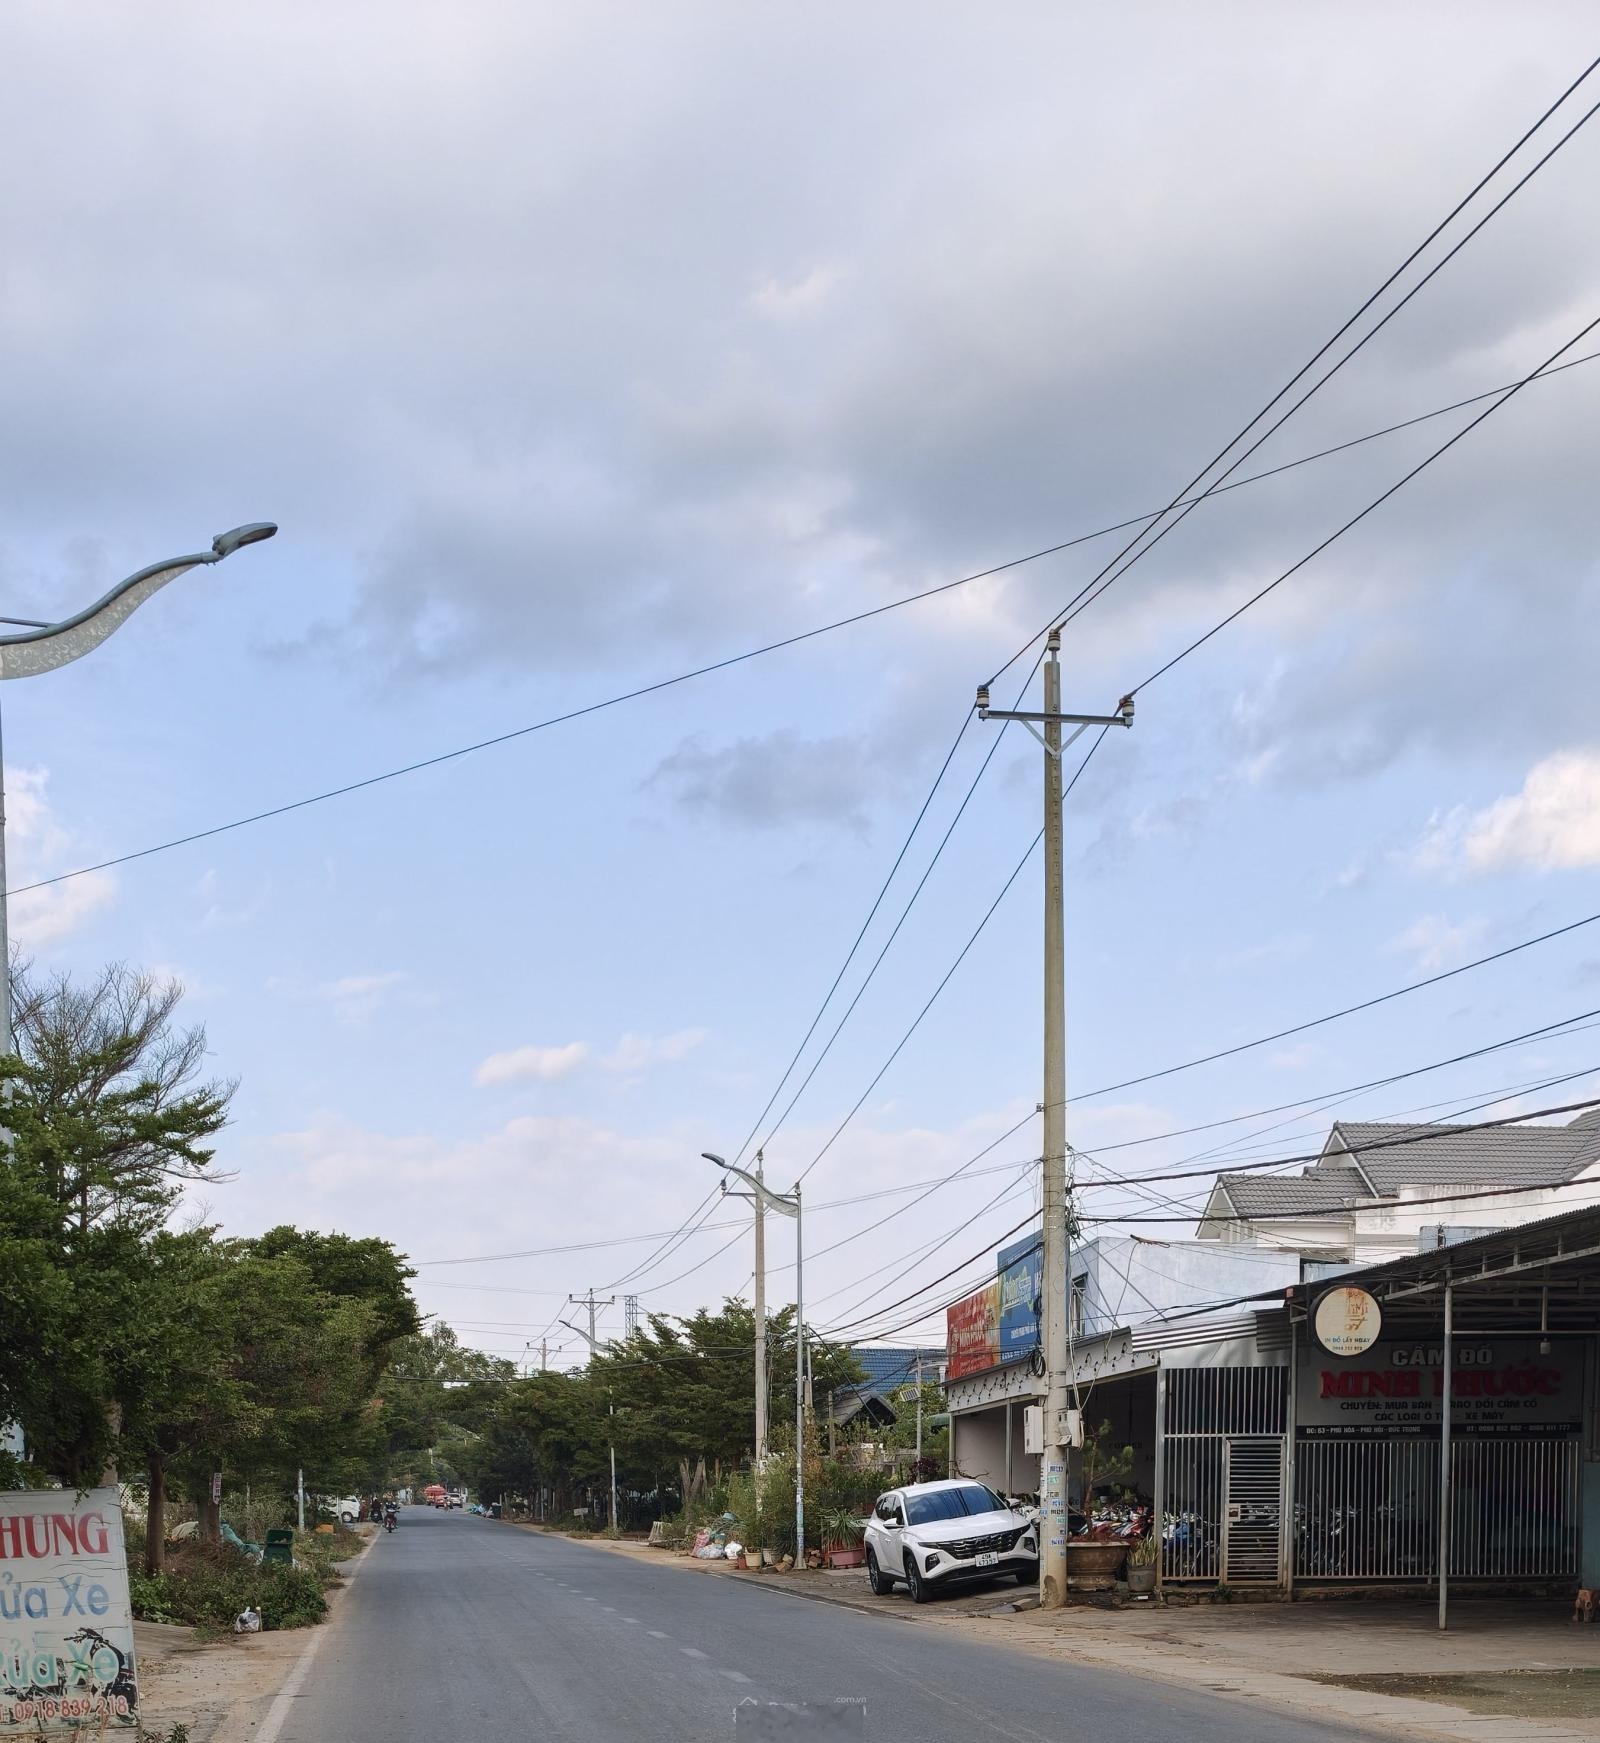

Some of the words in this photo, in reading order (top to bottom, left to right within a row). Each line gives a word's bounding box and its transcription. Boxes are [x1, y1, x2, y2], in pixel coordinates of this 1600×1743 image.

[1392, 1344, 1444, 1366] CẦM
[1320, 1371, 1421, 1399] MINH
[1385, 1401, 1408, 1410] MUA
[0, 1512, 109, 1559] HUNG
[58, 1575, 110, 1617] Xe
[67, 1640, 119, 1686] Xe
[14, 1700, 56, 1722] 0918
[61, 1696, 91, 1719] 839
[96, 1694, 128, 1716] 218
